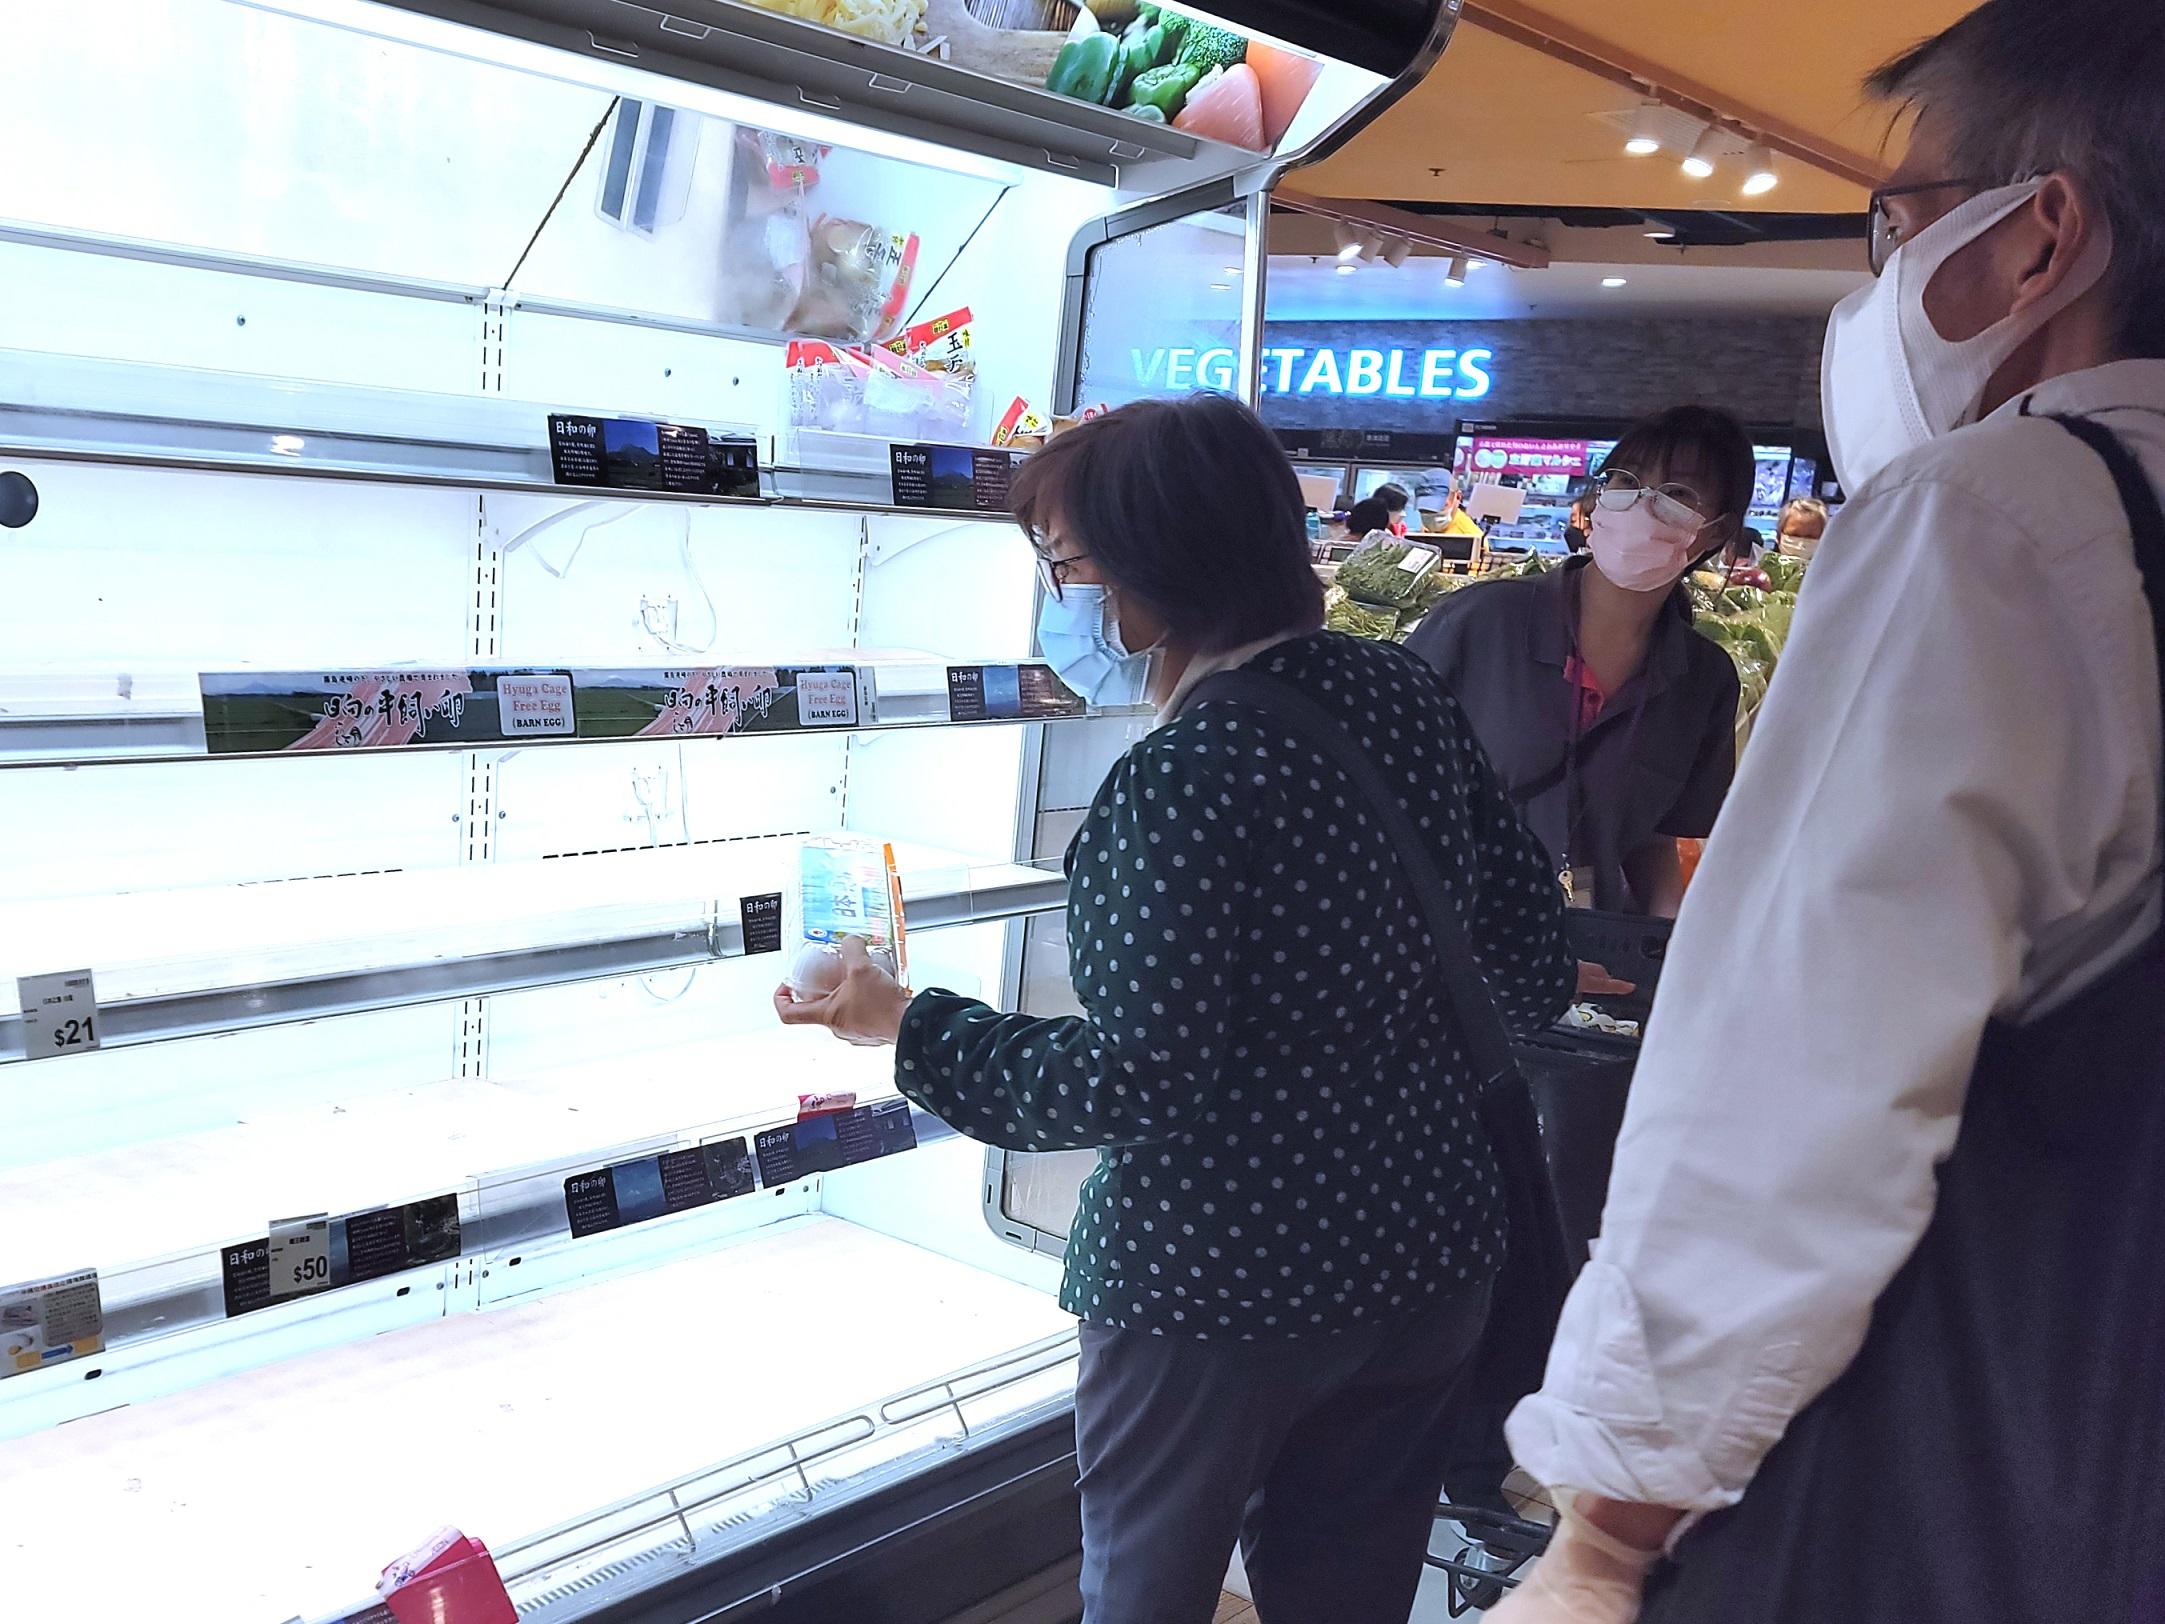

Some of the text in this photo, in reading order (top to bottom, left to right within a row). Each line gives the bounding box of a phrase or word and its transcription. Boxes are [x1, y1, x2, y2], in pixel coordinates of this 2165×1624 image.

[555, 420, 597, 439] 日和の卵
[503, 684, 567, 696] Hyuga Cage
[513, 700, 561, 712] Free Egg
[512, 717, 565, 728] (BARN EGG)
[54, 1016, 94, 1048] $21
[294, 1254, 328, 1284] $50
